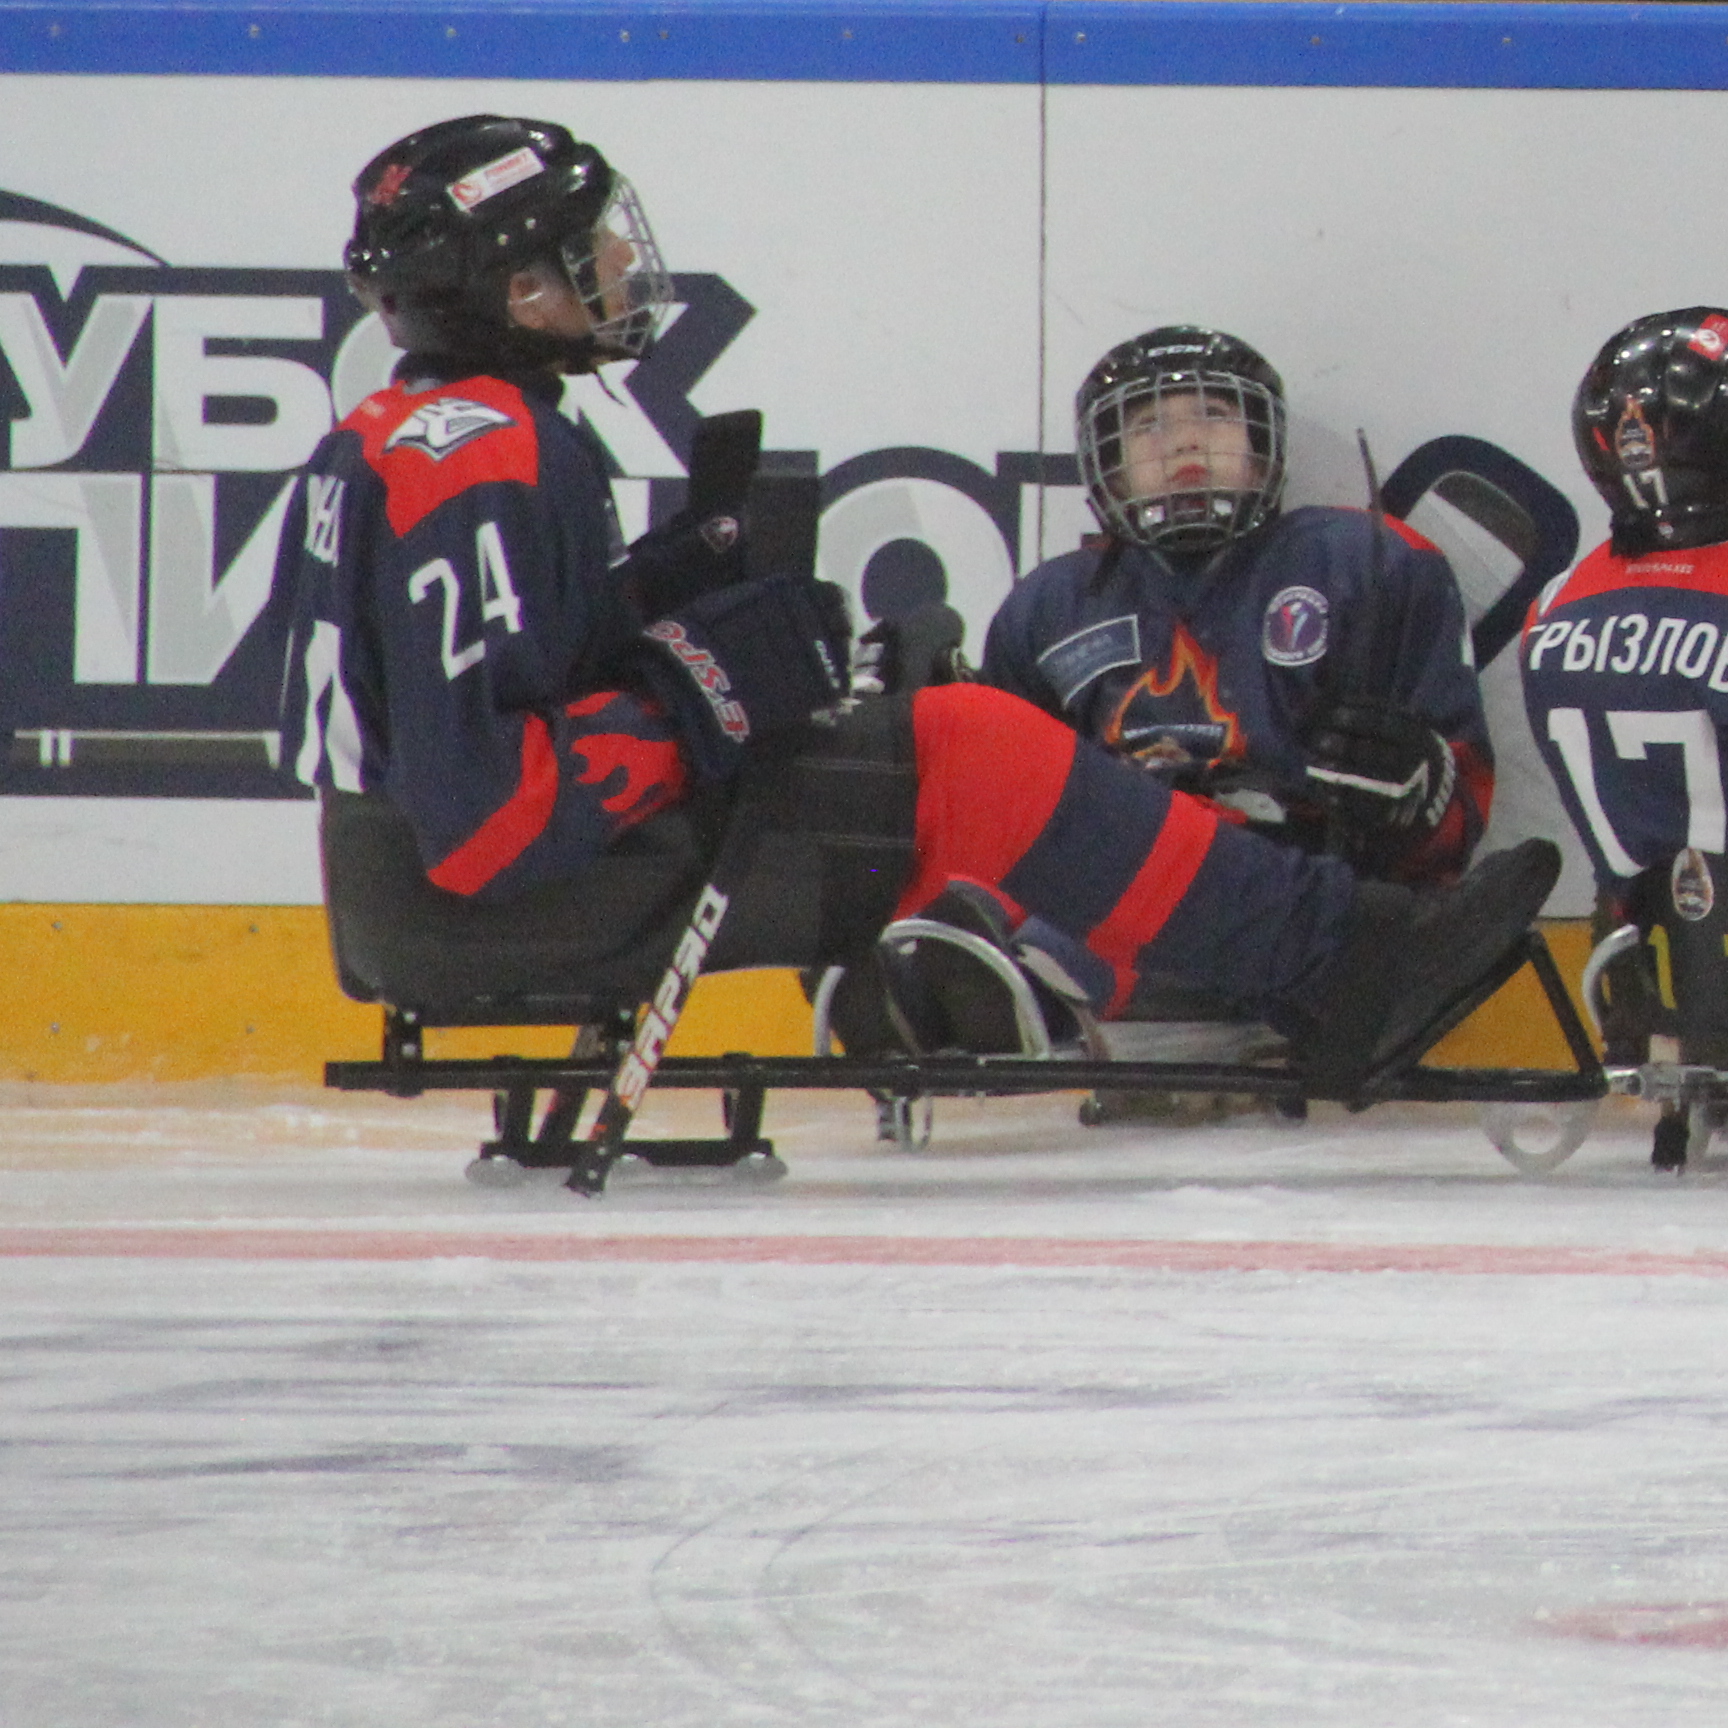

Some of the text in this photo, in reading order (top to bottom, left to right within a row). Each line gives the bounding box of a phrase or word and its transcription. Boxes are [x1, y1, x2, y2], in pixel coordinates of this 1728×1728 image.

[1622, 469, 1669, 509] 17
[409, 521, 523, 680] 24
[1547, 707, 1727, 878] 17
